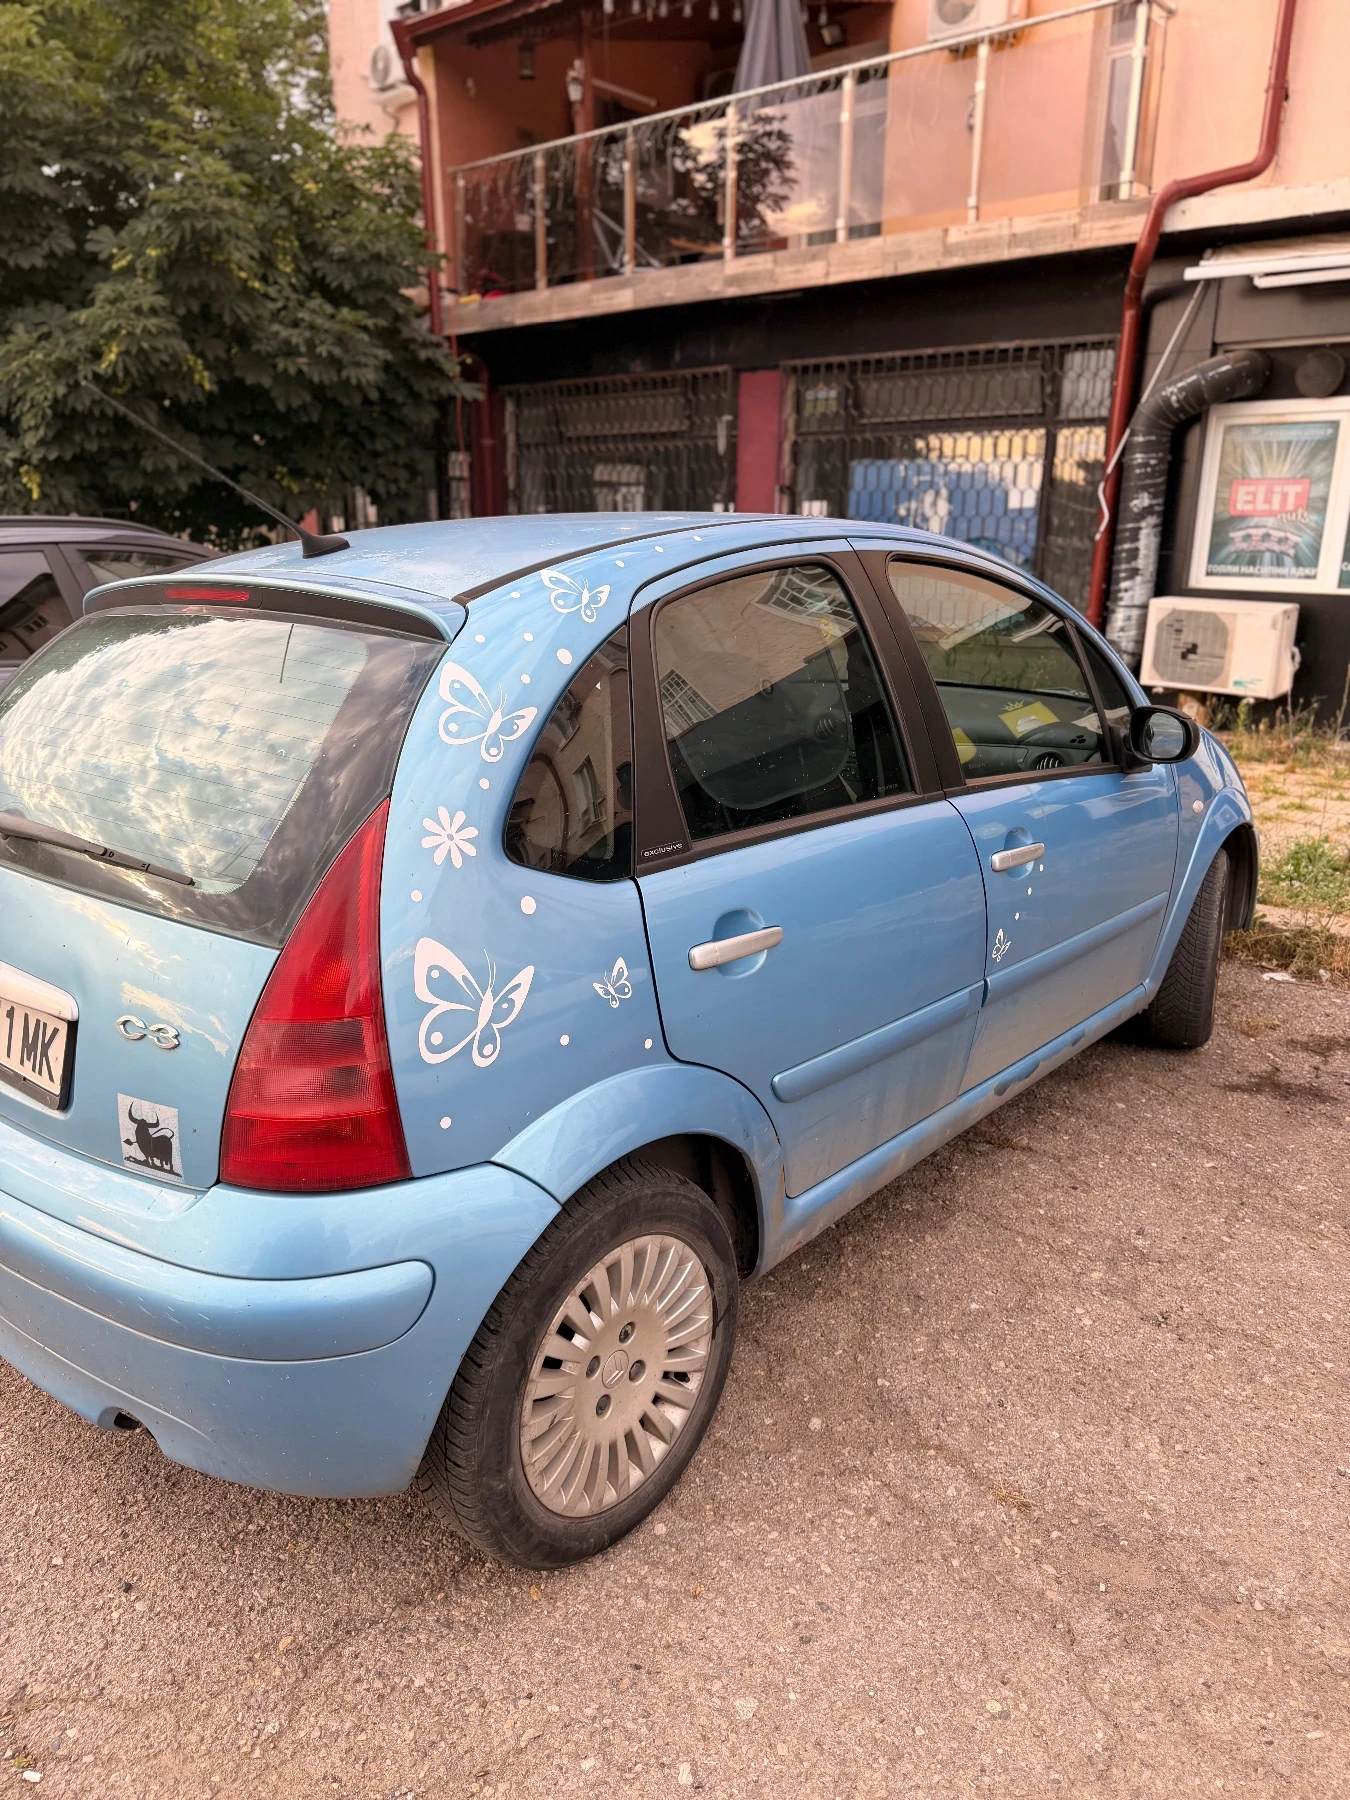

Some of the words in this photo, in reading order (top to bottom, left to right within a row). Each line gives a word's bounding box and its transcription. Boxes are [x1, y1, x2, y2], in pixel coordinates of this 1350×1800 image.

[643, 843, 683, 857] exclusive
[0, 1001, 15, 1059] 1
[20, 1012, 60, 1083] MK
[115, 1015, 180, 1050] C3
